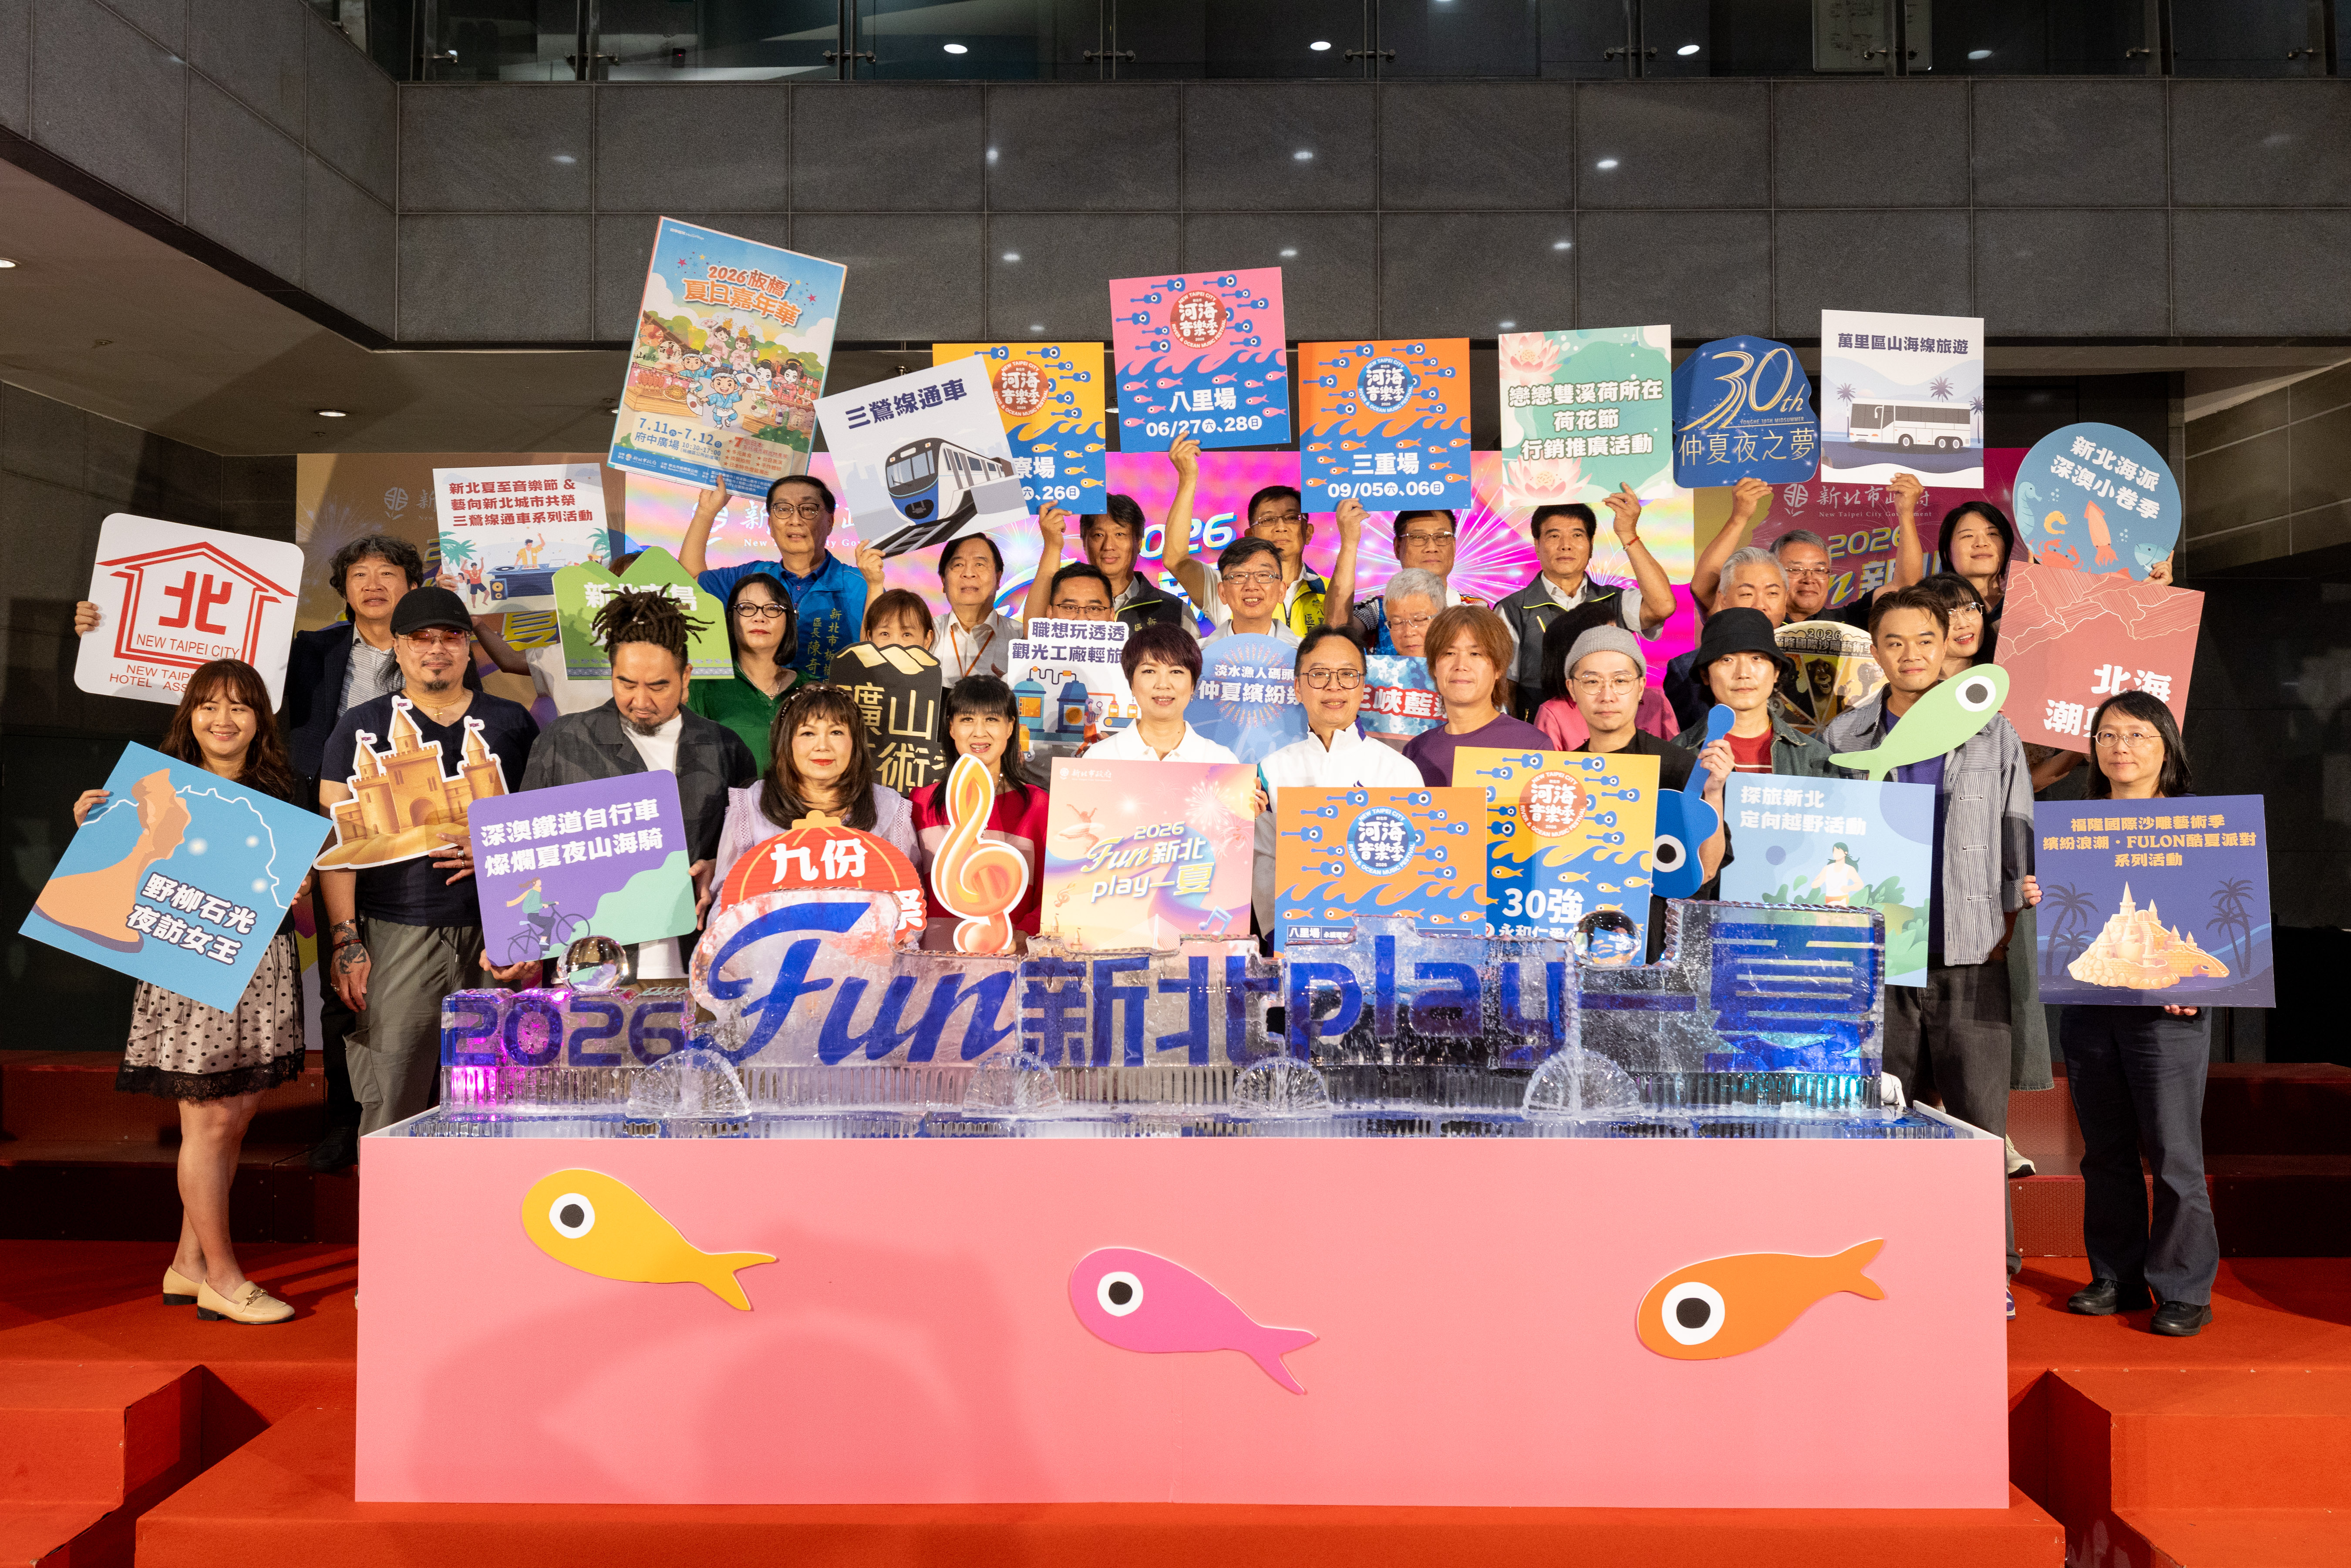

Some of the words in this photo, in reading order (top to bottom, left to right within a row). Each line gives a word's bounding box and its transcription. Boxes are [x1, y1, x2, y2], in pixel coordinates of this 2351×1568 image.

[684, 279, 801, 325] 夏日嘉年華
[1179, 301, 1218, 321] 河海
[1179, 319, 1218, 336] 音樂季
[1838, 333, 1969, 355] 萬里區山海線旅遊
[1001, 370, 1040, 388] 河海
[1366, 367, 1405, 386] 河海
[1001, 388, 1040, 404] 音樂季
[1170, 387, 1236, 413] 八里場
[1367, 385, 1405, 401] 音樂季
[1509, 379, 1663, 407] 戀戀雙溪荷所在
[845, 378, 967, 430] 三鶯線通車
[1553, 408, 1620, 432] 荷花節
[635, 432, 679, 451] 府中廣場
[1521, 433, 1653, 460] 行銷推廣活動
[1678, 428, 1815, 467] 仲夏夜之夢
[1352, 452, 1419, 475] 三重場
[2070, 435, 2160, 492] 新北海派
[449, 479, 559, 495] 新北夏至音樂節
[563, 479, 576, 490] &
[2050, 454, 2161, 520] 深澳小卷季
[450, 494, 576, 511] 藝向新北城市共榮
[452, 509, 593, 527] 三鶯線通車系列活動
[1032, 621, 1125, 641] 職想玩透透
[1807, 628, 1842, 639] 2026
[136, 633, 166, 648] NEW
[170, 638, 208, 655] TAIPEI
[212, 645, 240, 659] CITY
[109, 673, 152, 688] HOTEL
[126, 664, 158, 677] NEW
[1214, 664, 1294, 680] 淡水漁人碼頭
[1531, 784, 1577, 804] 河海
[1740, 785, 1824, 808] 探旅新北
[481, 798, 660, 847] 深澳鐵道自行車
[1529, 803, 1575, 824] 音樂季
[1740, 810, 1867, 836] 定向越野活動
[2071, 814, 2225, 833] 福隆國際沙雕藝術季
[1134, 821, 1186, 840] 2026
[1358, 820, 1406, 841] 河海
[485, 828, 663, 878] 燦爛夏夜山海騎
[770, 838, 868, 884] 九份
[1358, 841, 1405, 861] 音樂季
[2115, 853, 2183, 868] 系列活動
[143, 873, 256, 933] 野柳石光
[1502, 888, 1584, 923] 30強
[128, 905, 242, 964] 夜訪女王
[1289, 928, 1320, 938] 八里場
[441, 997, 686, 1067] 2026
